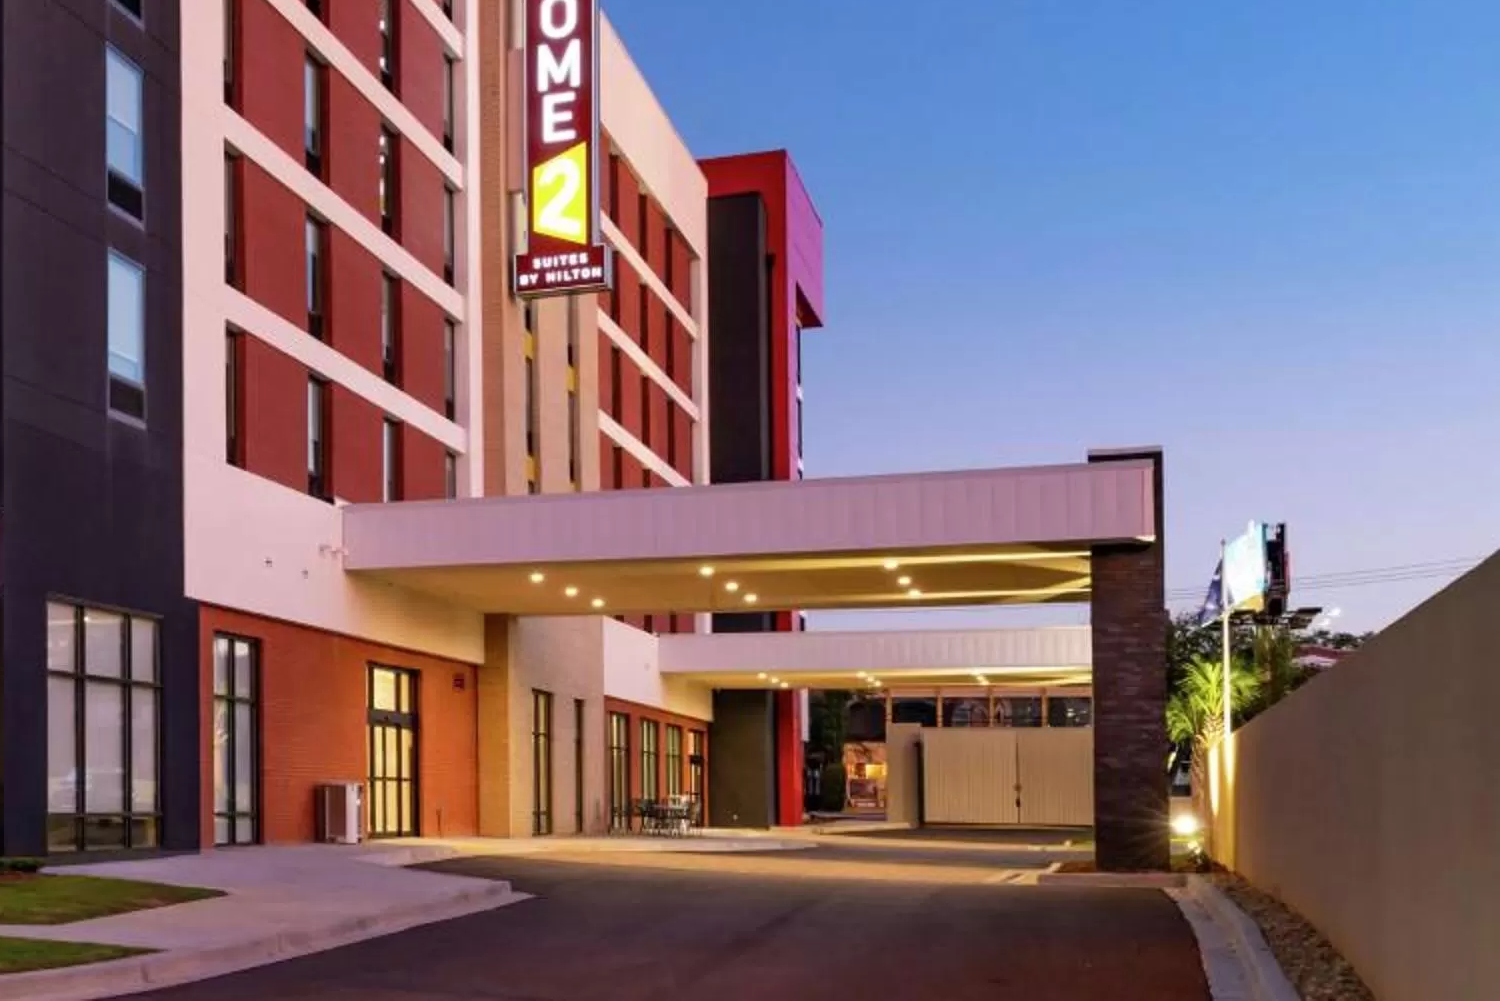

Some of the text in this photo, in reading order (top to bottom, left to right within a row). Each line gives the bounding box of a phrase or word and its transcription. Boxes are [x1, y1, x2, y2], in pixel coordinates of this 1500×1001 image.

[538, 156, 582, 236] 2
[532, 252, 589, 270] SUITES
[519, 267, 602, 287] BY HILTON
